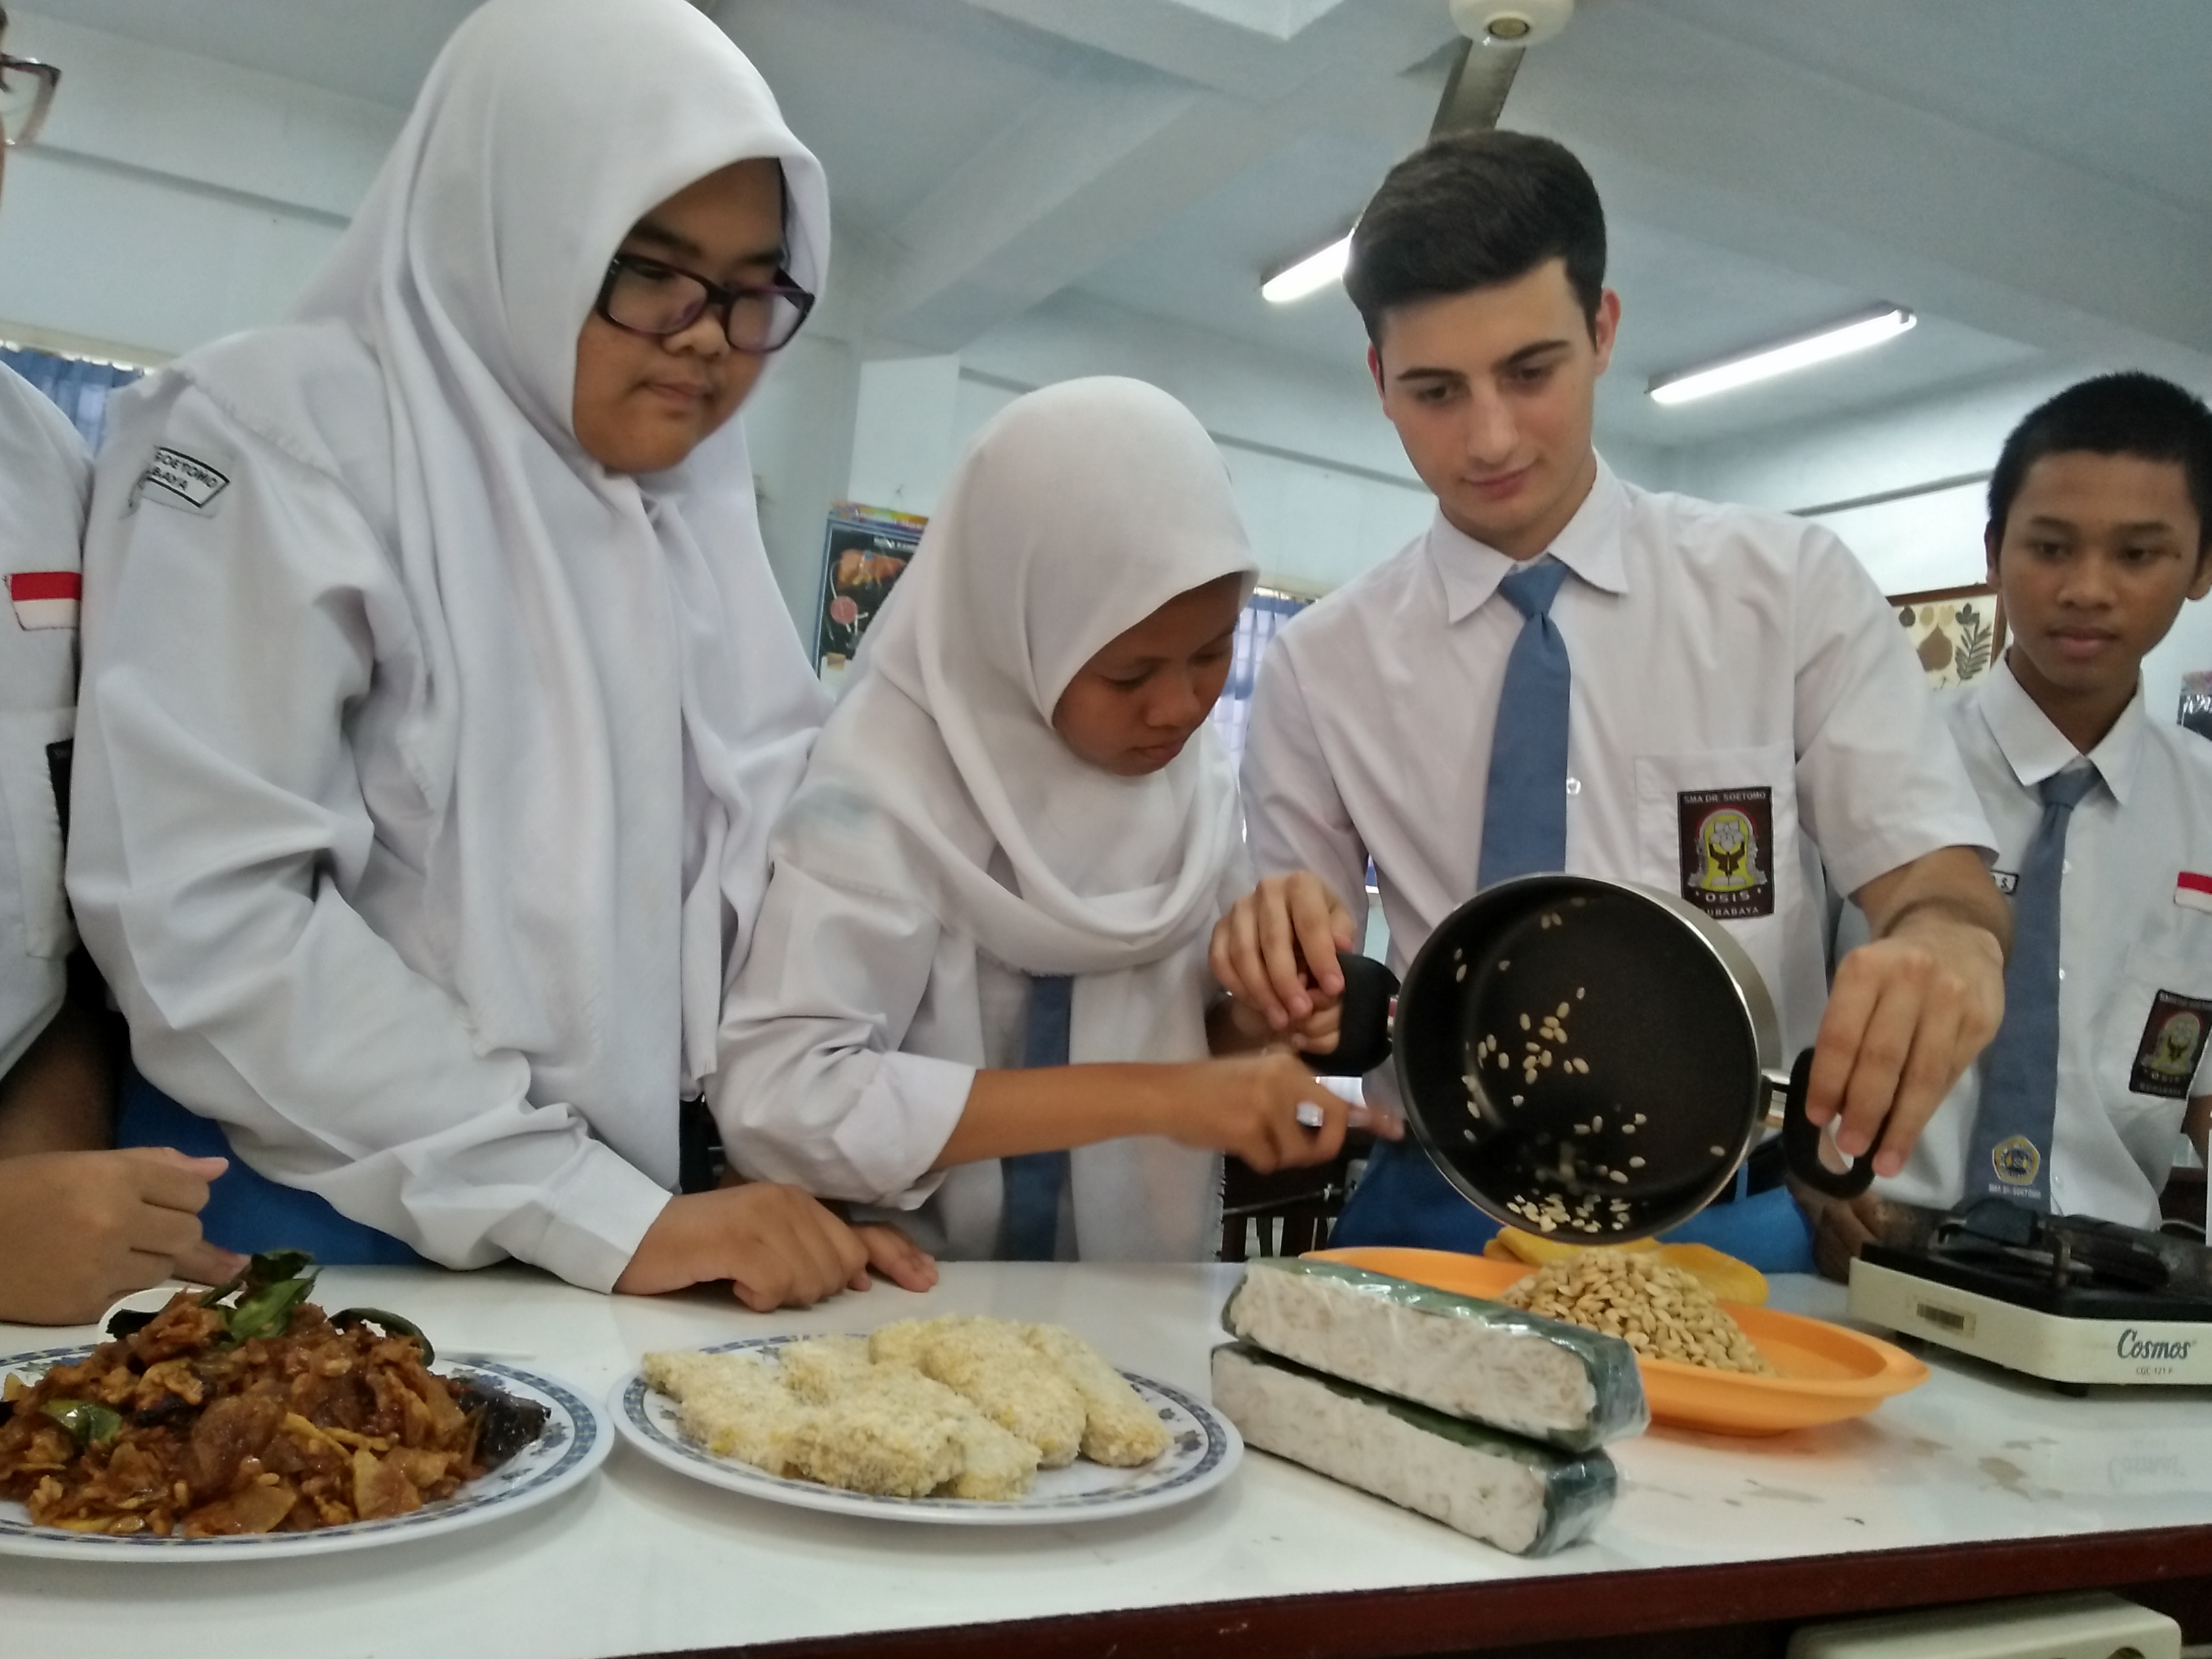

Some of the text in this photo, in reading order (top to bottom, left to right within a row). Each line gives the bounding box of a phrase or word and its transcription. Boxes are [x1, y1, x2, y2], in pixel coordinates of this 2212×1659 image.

[1684, 792, 1766, 803] SMA DR SOETOMO
[1705, 889, 1750, 903] OSIS
[1705, 906, 1759, 916] URABAYA
[2117, 1328, 2191, 1359] Cosmos
